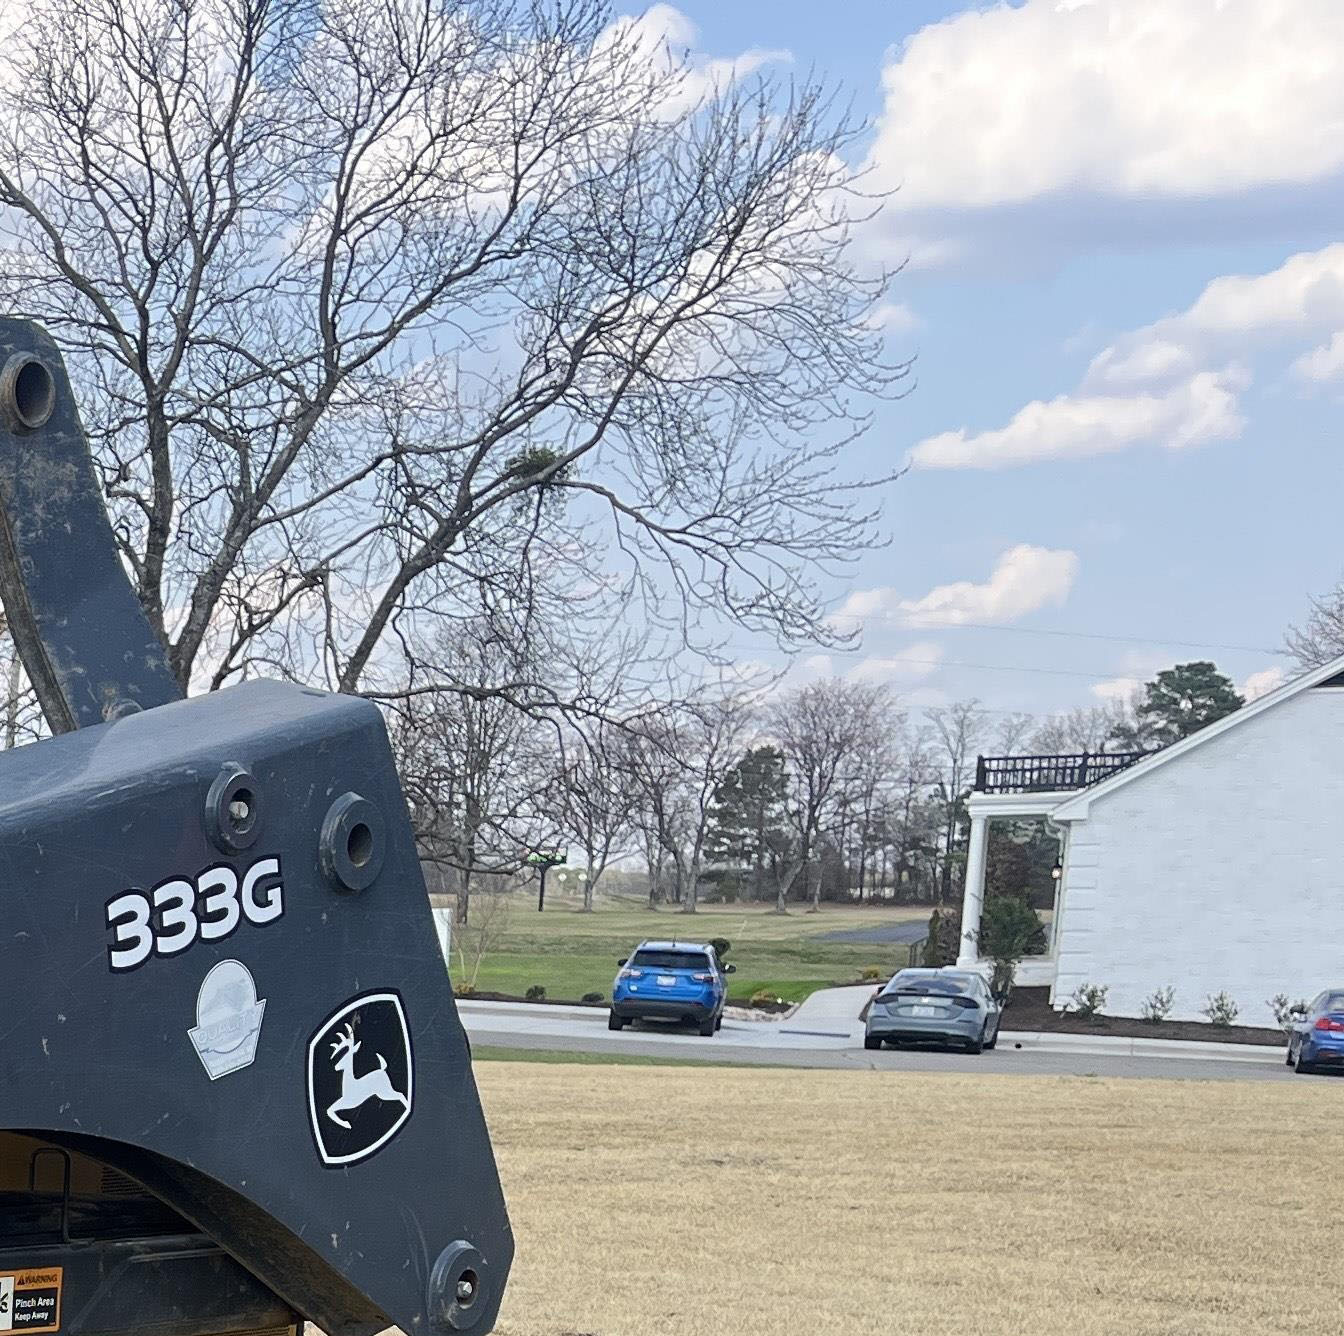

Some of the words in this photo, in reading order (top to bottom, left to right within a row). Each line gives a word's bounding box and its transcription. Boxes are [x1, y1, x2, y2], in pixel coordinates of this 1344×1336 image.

[107, 858, 283, 968] 333G
[25, 1273, 57, 1284] WARNING
[15, 1297, 36, 1308] Pinch
[37, 1296, 54, 1307] Area
[14, 1312, 31, 1322] Keep
[31, 1311, 49, 1321] Away
